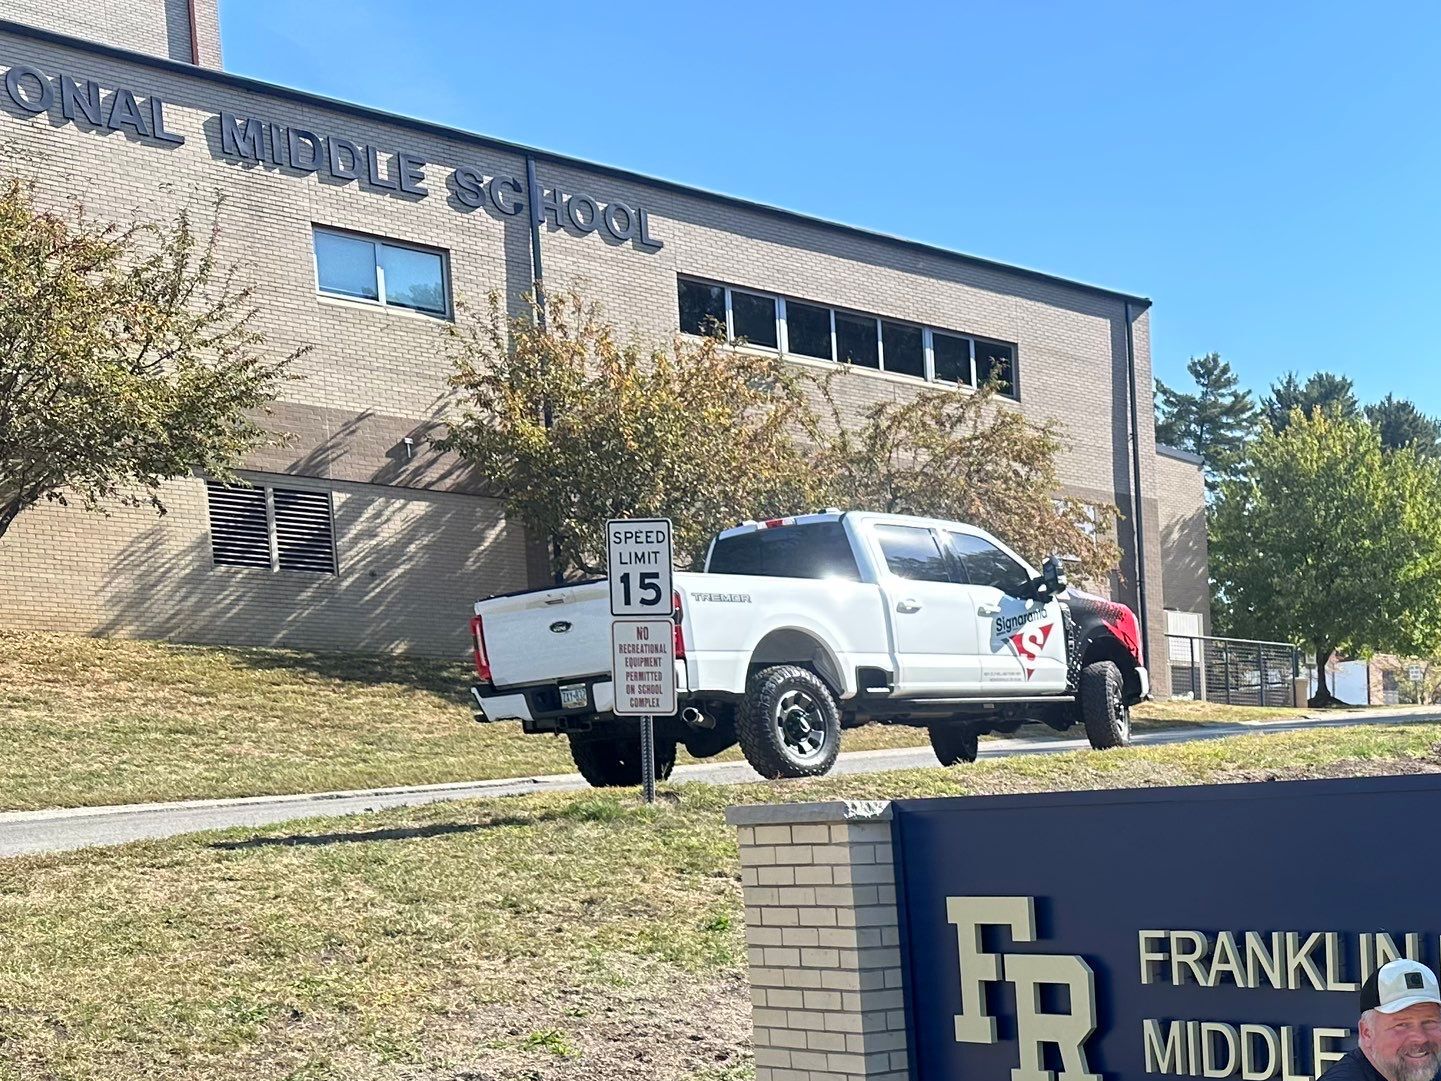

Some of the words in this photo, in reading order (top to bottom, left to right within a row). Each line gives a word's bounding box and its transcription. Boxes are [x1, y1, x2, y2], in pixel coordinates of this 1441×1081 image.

[5, 64, 185, 145] ONAL
[219, 110, 428, 198] MIDDLE
[455, 165, 664, 249] SCHOOL
[613, 530, 665, 545] SPEED
[619, 551, 661, 565] LIMIT
[619, 572, 662, 607] 15
[690, 592, 752, 603] TREMOR
[995, 608, 1047, 633] Signarama
[636, 626, 649, 641] NO
[618, 643, 667, 655] RECREATIONAL
[624, 656, 662, 668] EQUIPMENT
[625, 670, 662, 682] PERMITTED
[625, 684, 636, 696] ON
[637, 683, 663, 695] SCHOOL
[629, 696, 660, 708] COMPLEX
